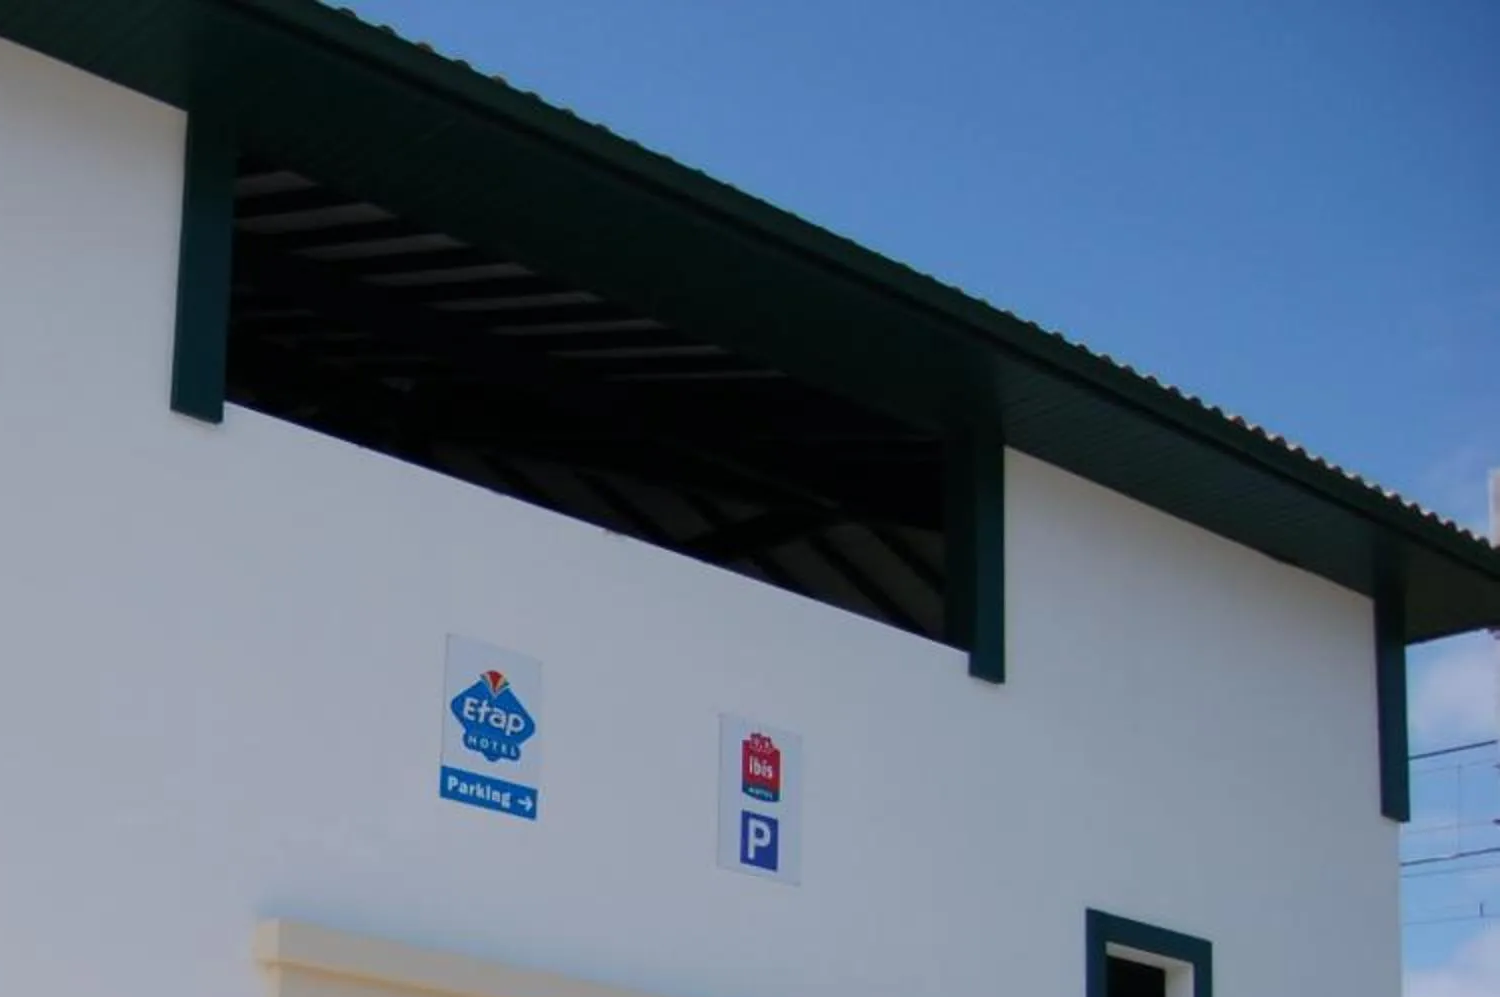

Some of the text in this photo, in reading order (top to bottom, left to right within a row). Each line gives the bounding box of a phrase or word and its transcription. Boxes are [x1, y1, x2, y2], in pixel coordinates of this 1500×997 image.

[462, 697, 526, 737] Etap
[467, 735, 518, 758] HOTEL
[748, 754, 773, 779] ibis
[446, 775, 512, 809] Parking
[747, 819, 772, 861] P
